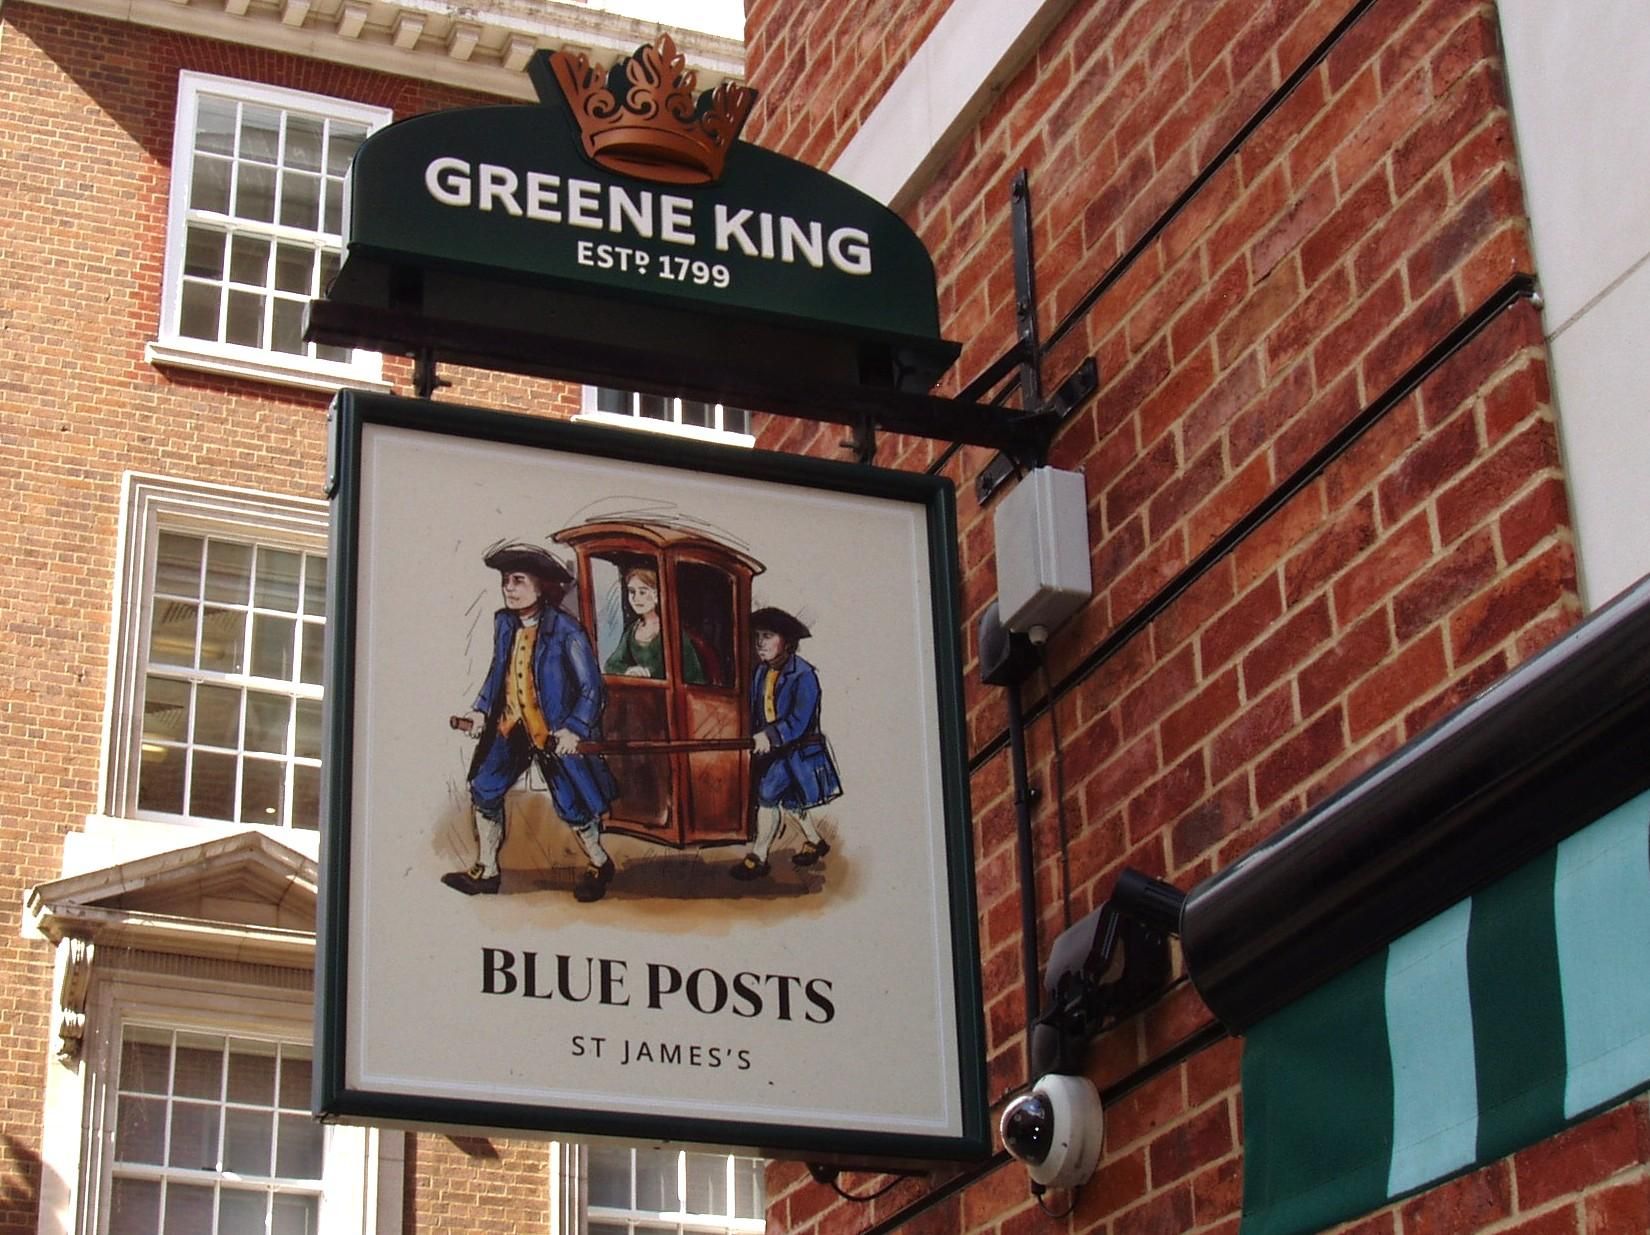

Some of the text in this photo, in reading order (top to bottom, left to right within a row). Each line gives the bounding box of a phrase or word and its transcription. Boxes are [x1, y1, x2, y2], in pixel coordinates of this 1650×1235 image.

[425, 156, 873, 275] GREENE KING
[659, 255, 730, 289] 1799
[480, 947, 836, 1024] BLUE POSTS
[571, 1035, 751, 1070] ST JAMES'S
